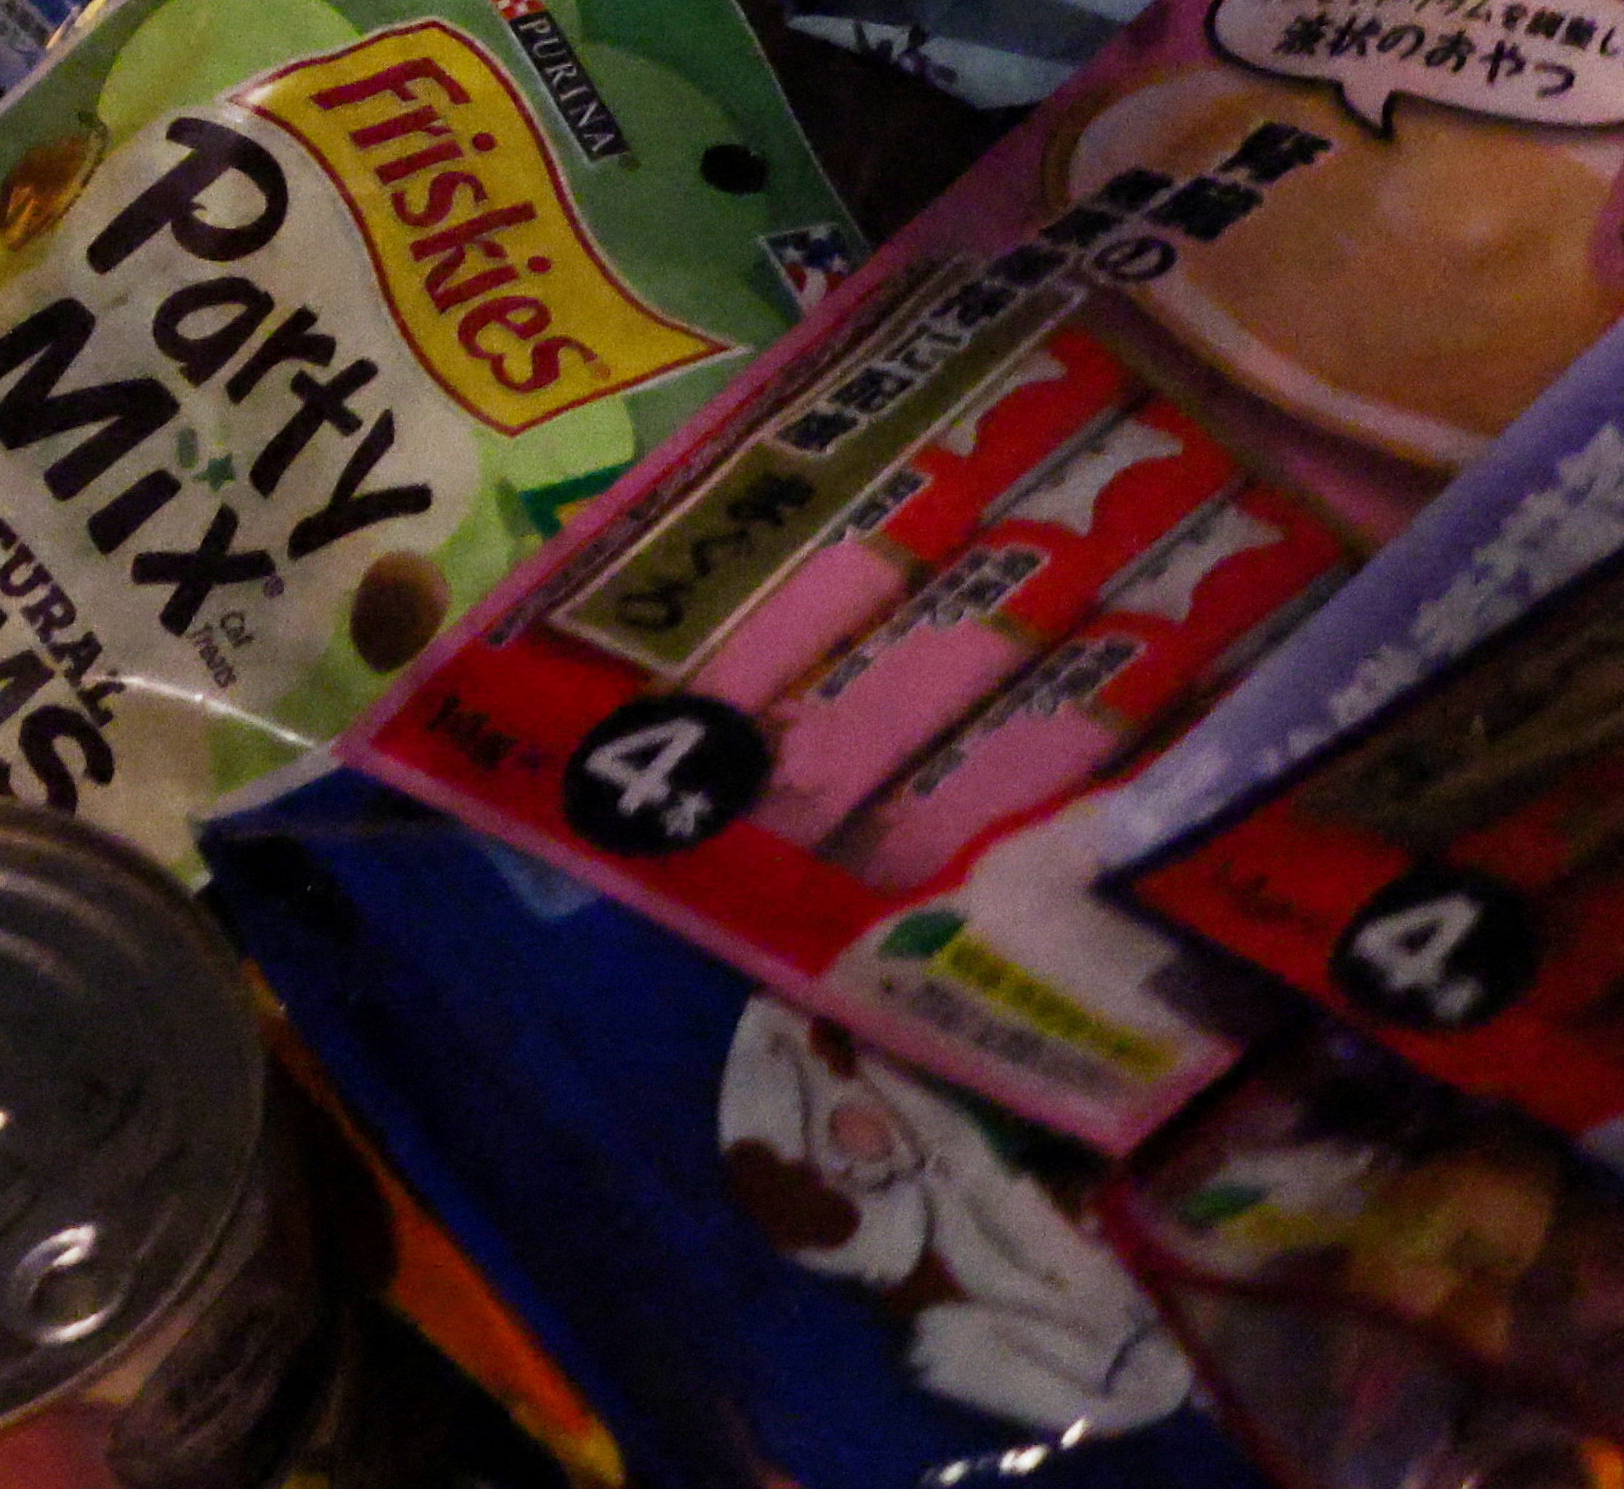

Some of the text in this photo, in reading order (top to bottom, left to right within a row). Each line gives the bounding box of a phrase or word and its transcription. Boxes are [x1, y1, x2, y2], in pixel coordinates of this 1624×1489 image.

[307, 56, 601, 396] Friskies
[517, 13, 619, 156] PURINA
[86, 116, 433, 561] Party
